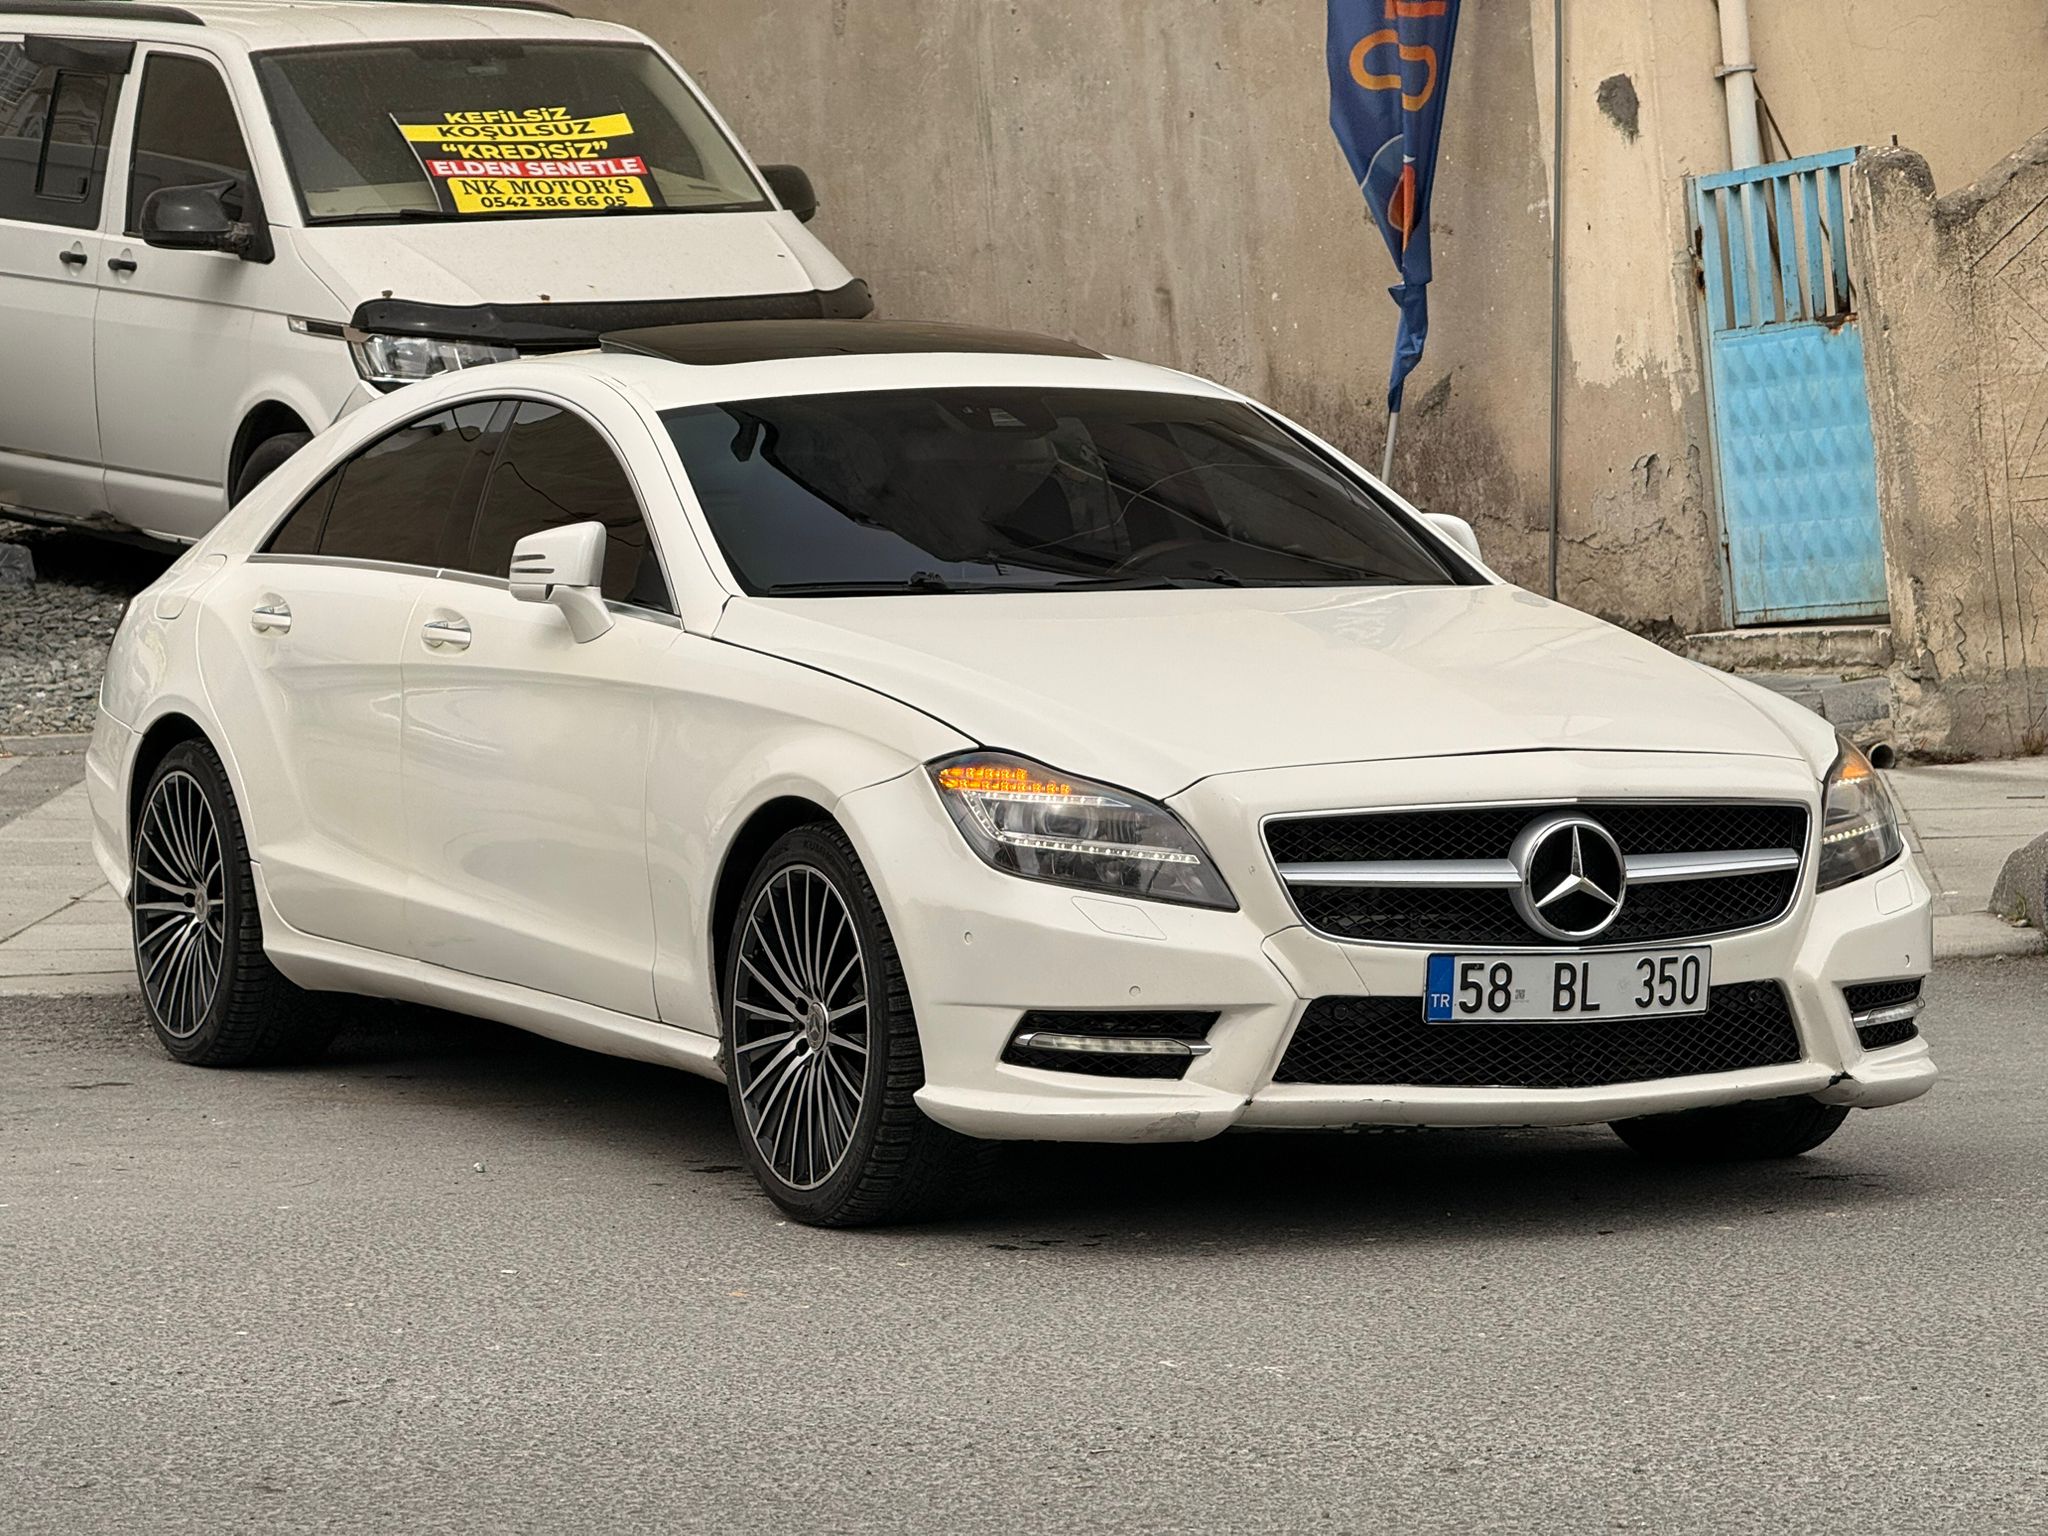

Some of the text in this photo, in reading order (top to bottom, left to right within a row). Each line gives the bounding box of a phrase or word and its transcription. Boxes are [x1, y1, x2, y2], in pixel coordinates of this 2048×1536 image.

[438, 122, 595, 140] KOŞULSUZ
[433, 159, 640, 176] ELDEN SENETLE
[458, 179, 505, 195] NK
[481, 195, 628, 208] 0542 386 66 05
[1459, 956, 1699, 1014] 58 BL 350
[1431, 993, 1450, 1009] TR
